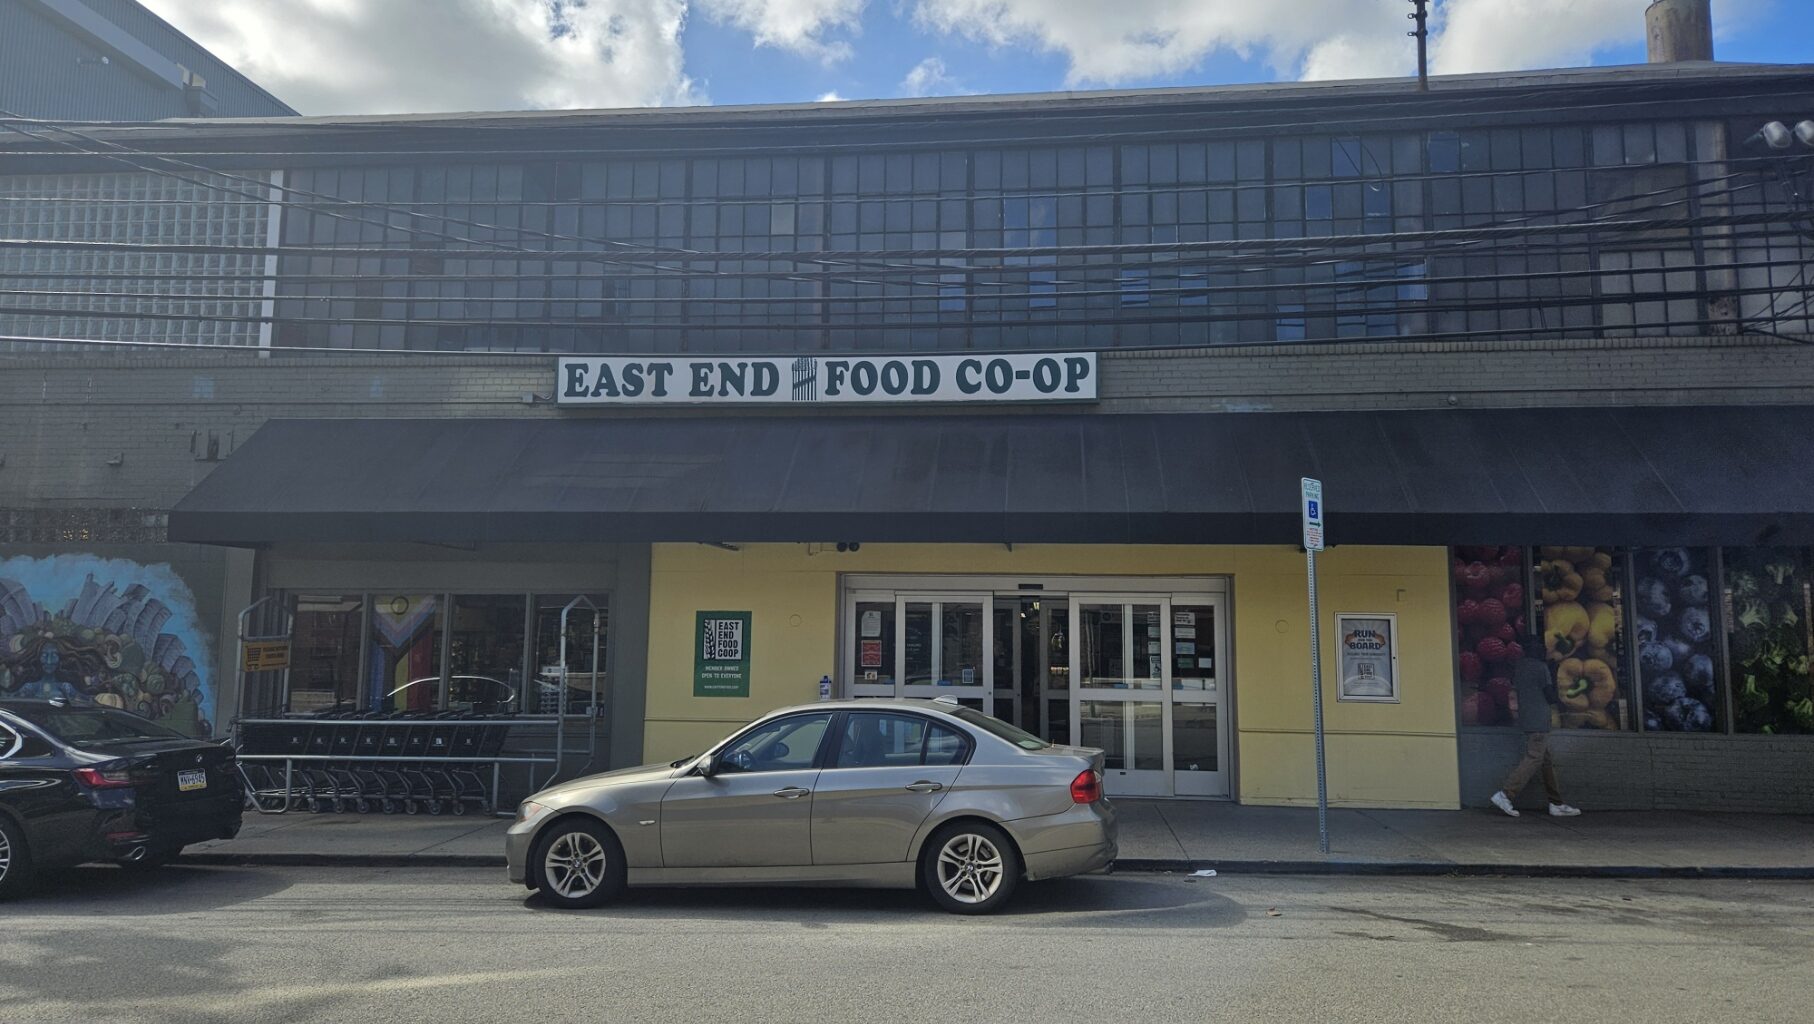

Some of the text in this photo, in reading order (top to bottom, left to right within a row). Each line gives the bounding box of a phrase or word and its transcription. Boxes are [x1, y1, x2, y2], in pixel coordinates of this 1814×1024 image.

[564, 357, 1090, 397] EAST END FOOD CO-OP
[718, 622, 739, 630] EAST
[718, 631, 734, 639] END
[1354, 630, 1376, 638] RUN
[718, 640, 738, 648] FOOD
[1350, 642, 1381, 650] BOARD
[717, 649, 739, 657] COOP
